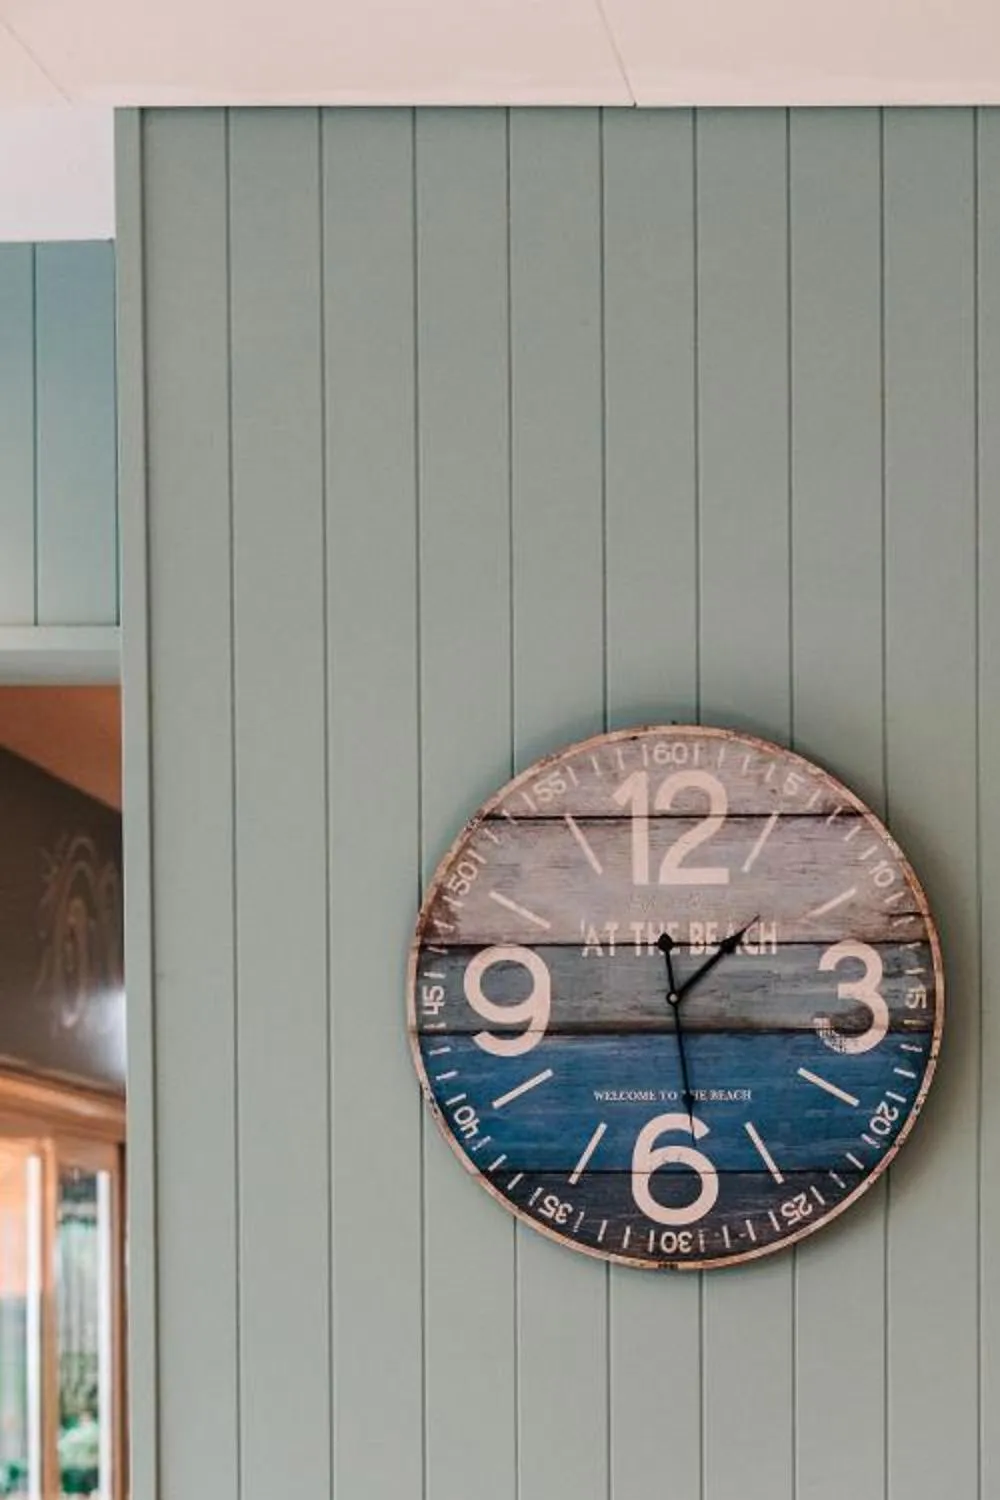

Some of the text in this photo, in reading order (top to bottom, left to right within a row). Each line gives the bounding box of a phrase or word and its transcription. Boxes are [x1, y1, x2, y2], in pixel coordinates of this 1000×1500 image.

[653, 741, 688, 764] 60
[533, 771, 567, 802] 55
[783, 772, 804, 797] 5
[612, 769, 730, 885] 12
[445, 861, 478, 897] 50
[869, 860, 895, 888] 10
[422, 985, 445, 1015] 45
[464, 944, 551, 1057] 9
[813, 939, 889, 1054] 3
[593, 1089, 753, 1101] WELCOME TO HE BEACH
[453, 1105, 481, 1139] 40
[870, 1101, 899, 1135] 20
[632, 1113, 719, 1225] 6
[539, 1195, 573, 1224] 35
[781, 1193, 813, 1226] 25
[661, 1231, 693, 1253] 30
